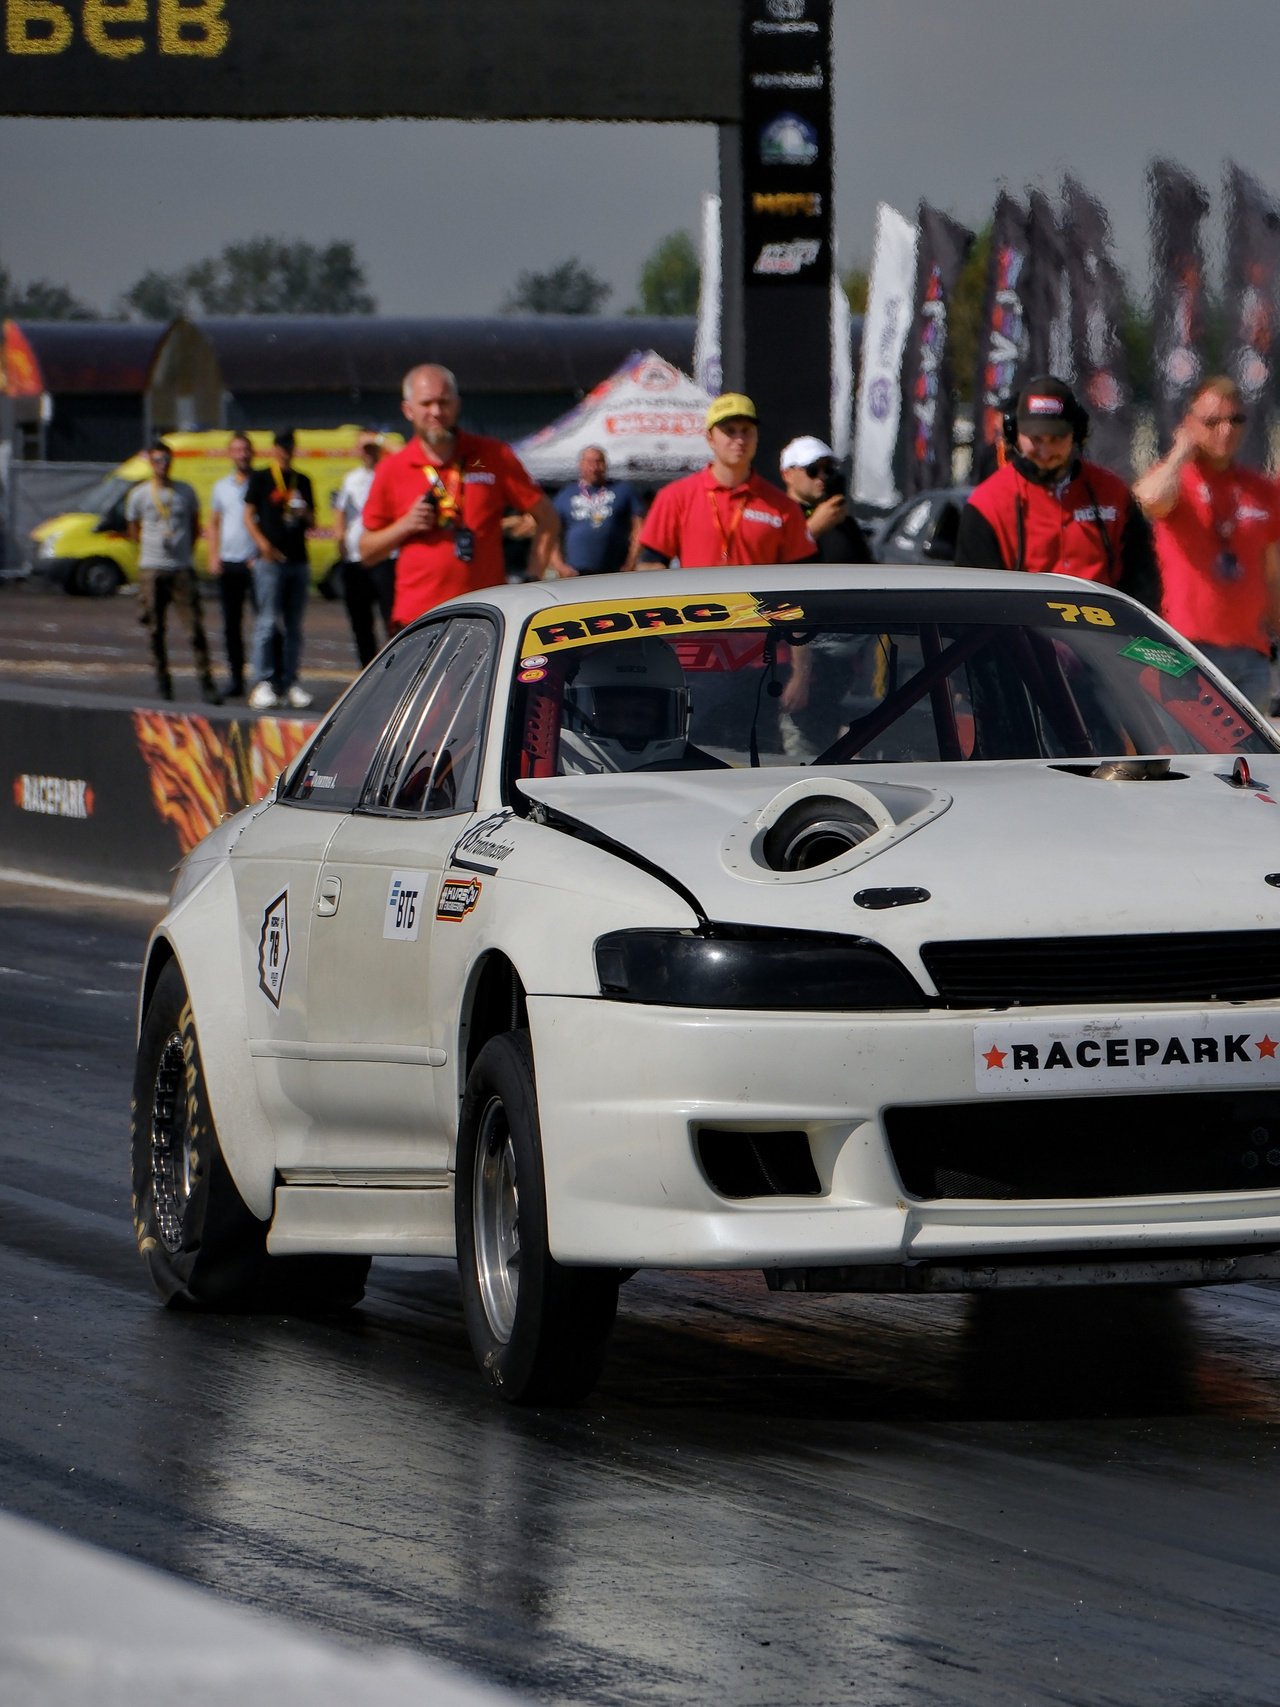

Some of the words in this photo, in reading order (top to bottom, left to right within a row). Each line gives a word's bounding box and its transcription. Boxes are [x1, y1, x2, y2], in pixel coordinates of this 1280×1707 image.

[531, 603, 731, 646] RDRC
[1046, 602, 1116, 627] 78
[396, 890, 419, 929] ВТБ
[269, 930, 281, 968] 78
[1011, 1034, 1252, 1070] RACEPARK
